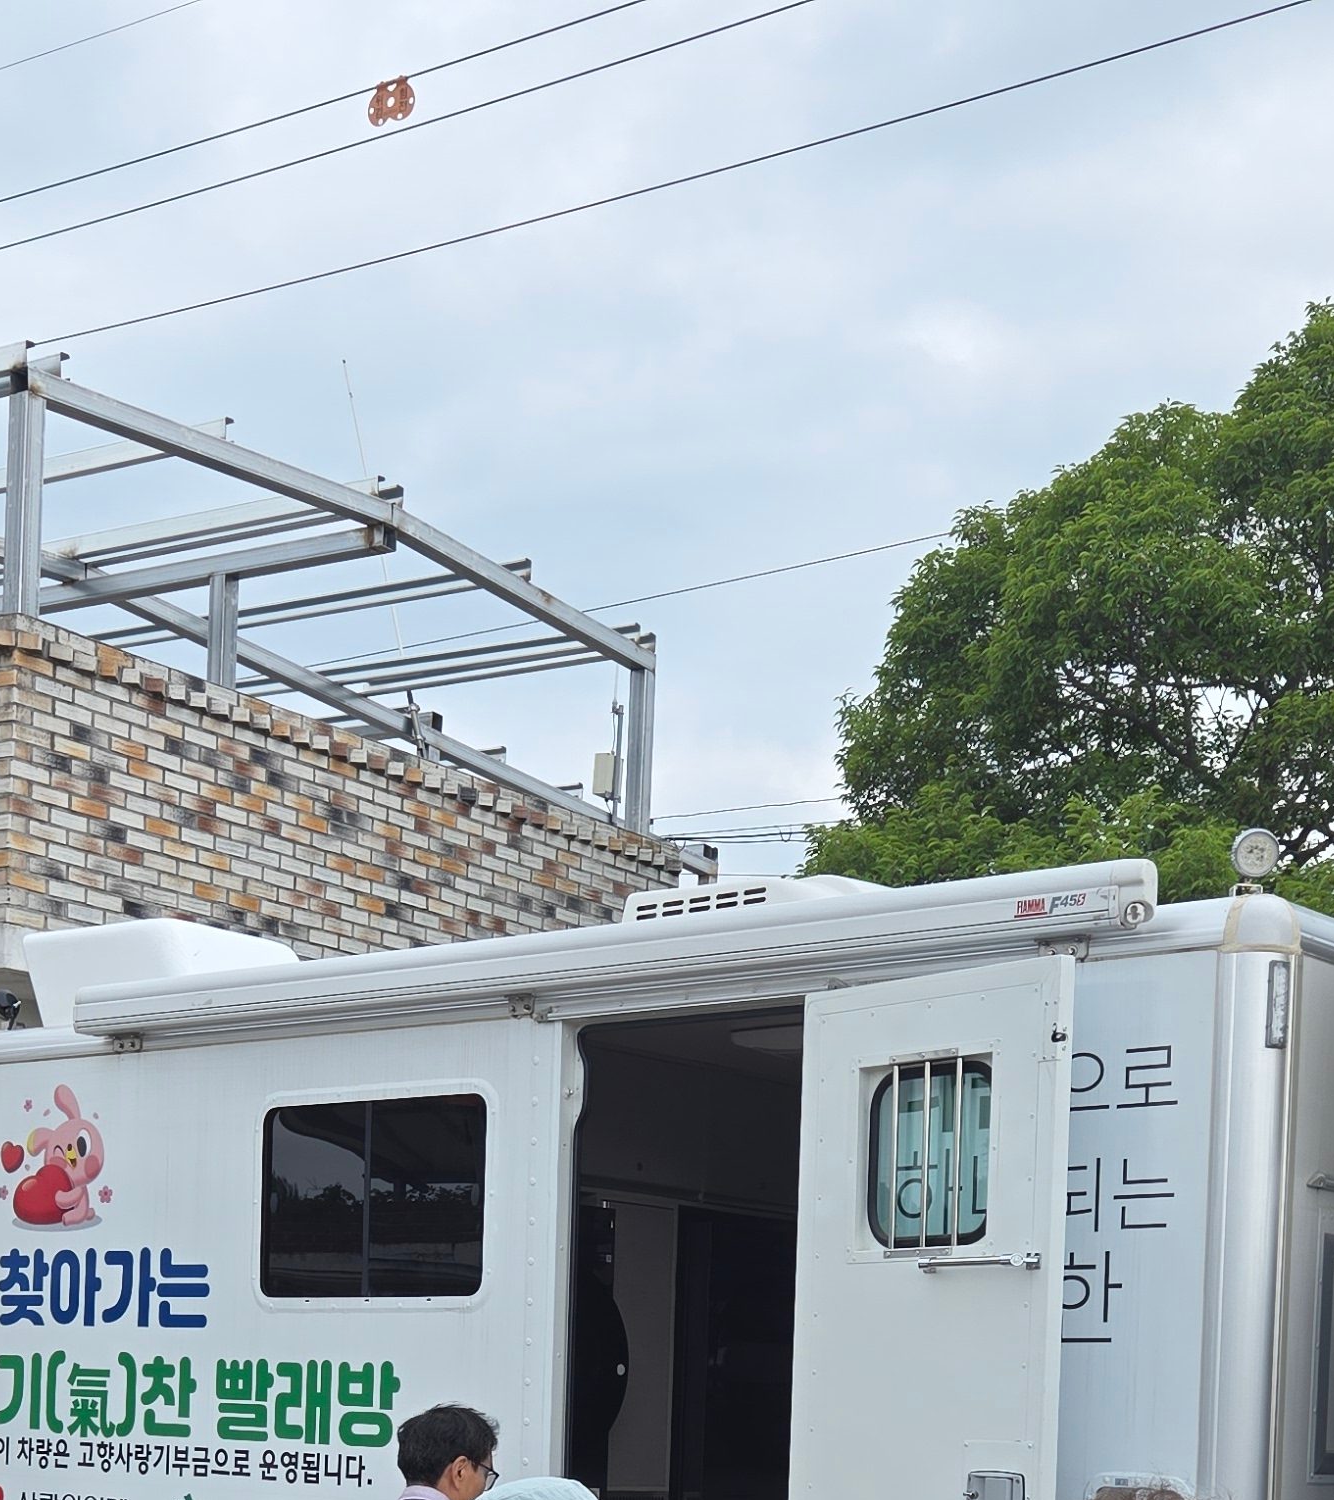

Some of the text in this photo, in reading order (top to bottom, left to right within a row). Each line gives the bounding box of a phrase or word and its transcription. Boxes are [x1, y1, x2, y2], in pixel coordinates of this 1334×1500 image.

[215, 1358, 401, 1448] 빨래방
[17, 1436, 70, 1470] 차량은
[77, 1441, 251, 1478] 고향사랑기부금으로
[258, 1448, 373, 1488] 운영됩니다.
